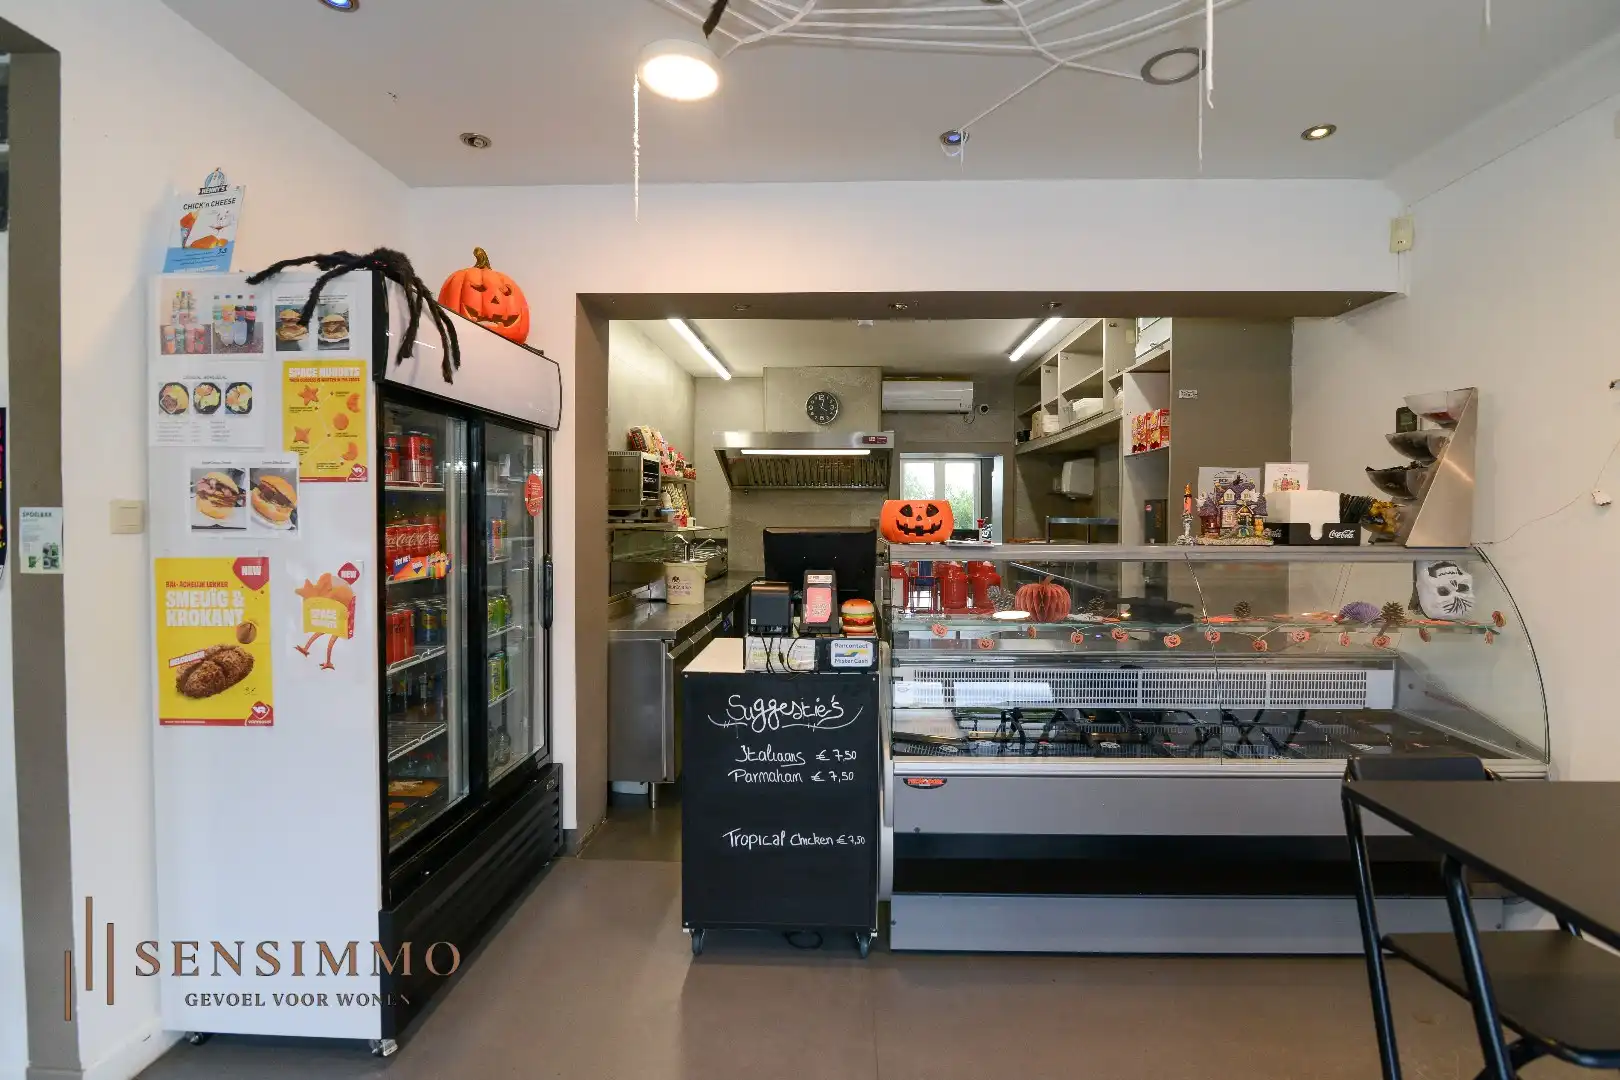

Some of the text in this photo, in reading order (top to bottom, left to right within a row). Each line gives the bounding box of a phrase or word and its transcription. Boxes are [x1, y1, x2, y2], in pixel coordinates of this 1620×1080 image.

[210, 197, 236, 208] CHEESE
[241, 565, 262, 576] NEW
[165, 608, 245, 628] KROKANT
[735, 744, 806, 767] Italiaans
[722, 827, 786, 850] Tropical
[790, 832, 834, 847] Chicken
